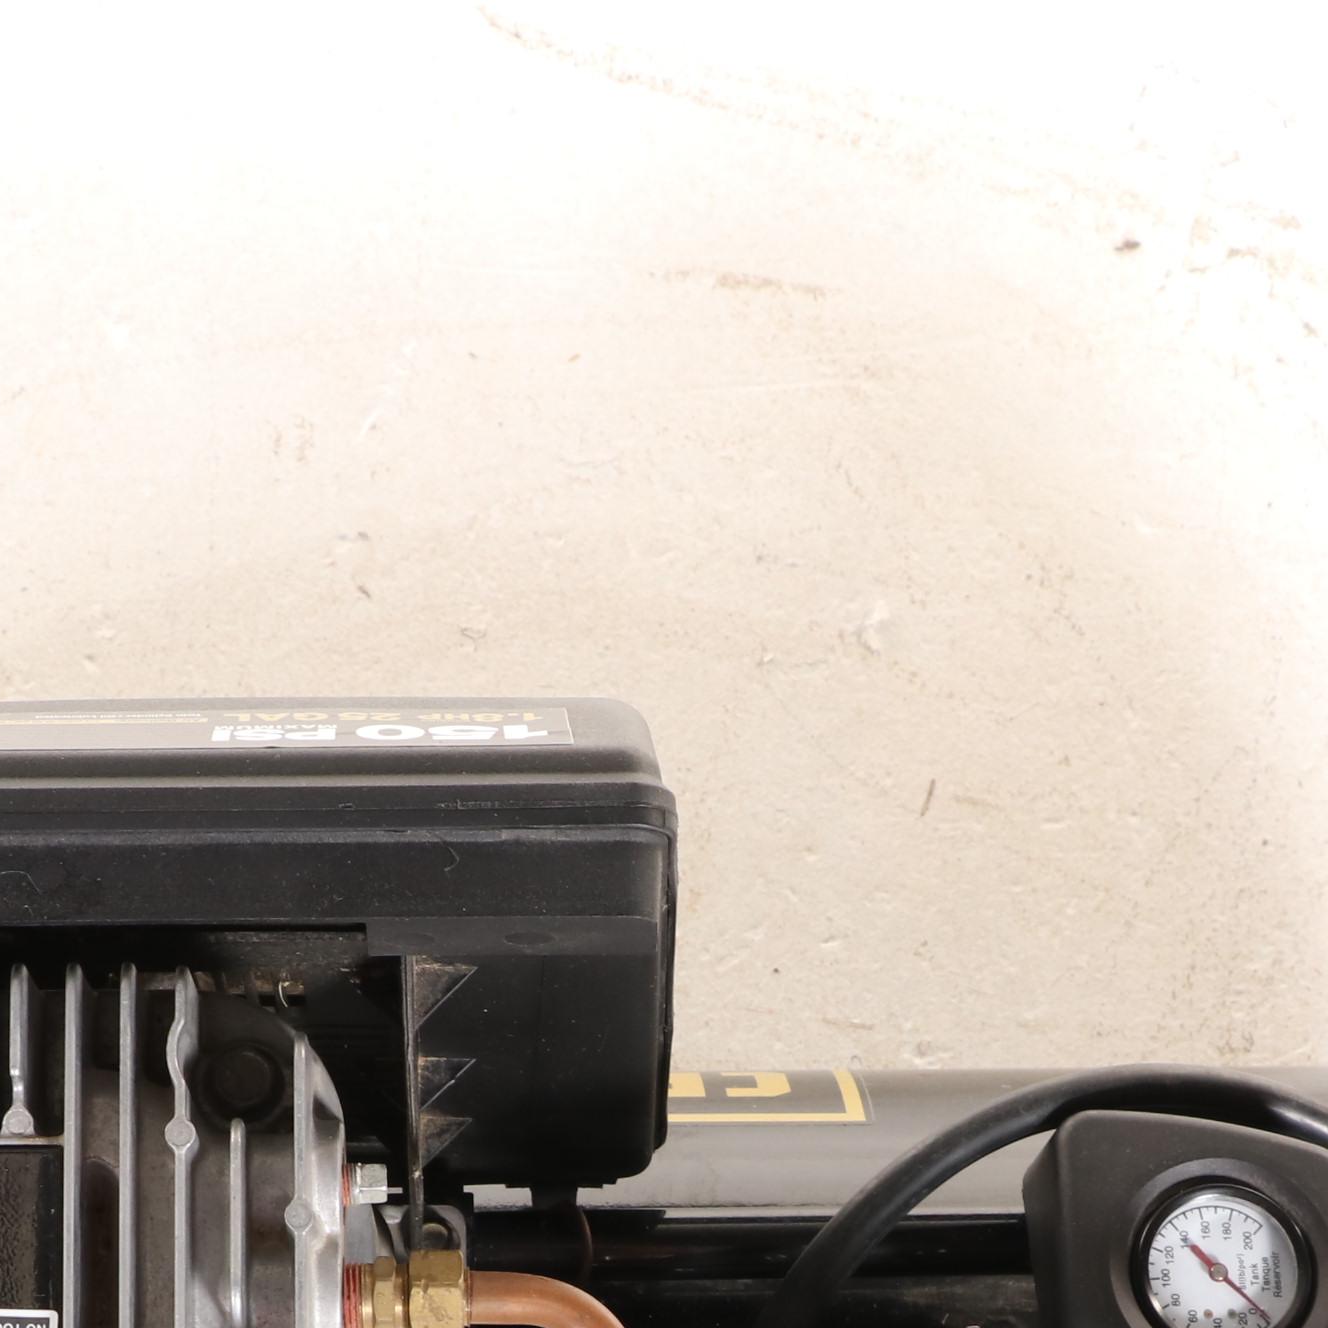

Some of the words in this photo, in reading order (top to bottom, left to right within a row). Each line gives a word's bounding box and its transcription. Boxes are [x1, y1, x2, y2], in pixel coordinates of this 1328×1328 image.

[223, 712, 329, 722] GAL
[338, 712, 401, 721] 25
[210, 727, 337, 742] PSI
[355, 724, 549, 741] 150
[1201, 1220, 1210, 1239] 160
[1222, 1222, 1231, 1240] 180
[1180, 1230, 1192, 1248] 140
[1242, 1231, 1253, 1250] 200
[1165, 1246, 1175, 1265] 120
[1161, 1268, 1171, 1287] 100
[1262, 1257, 1271, 1292] Tanque
[1171, 1293, 1181, 1307] 80
[1189, 1310, 1198, 1323] 60
[1238, 1312, 1248, 1325] 20
